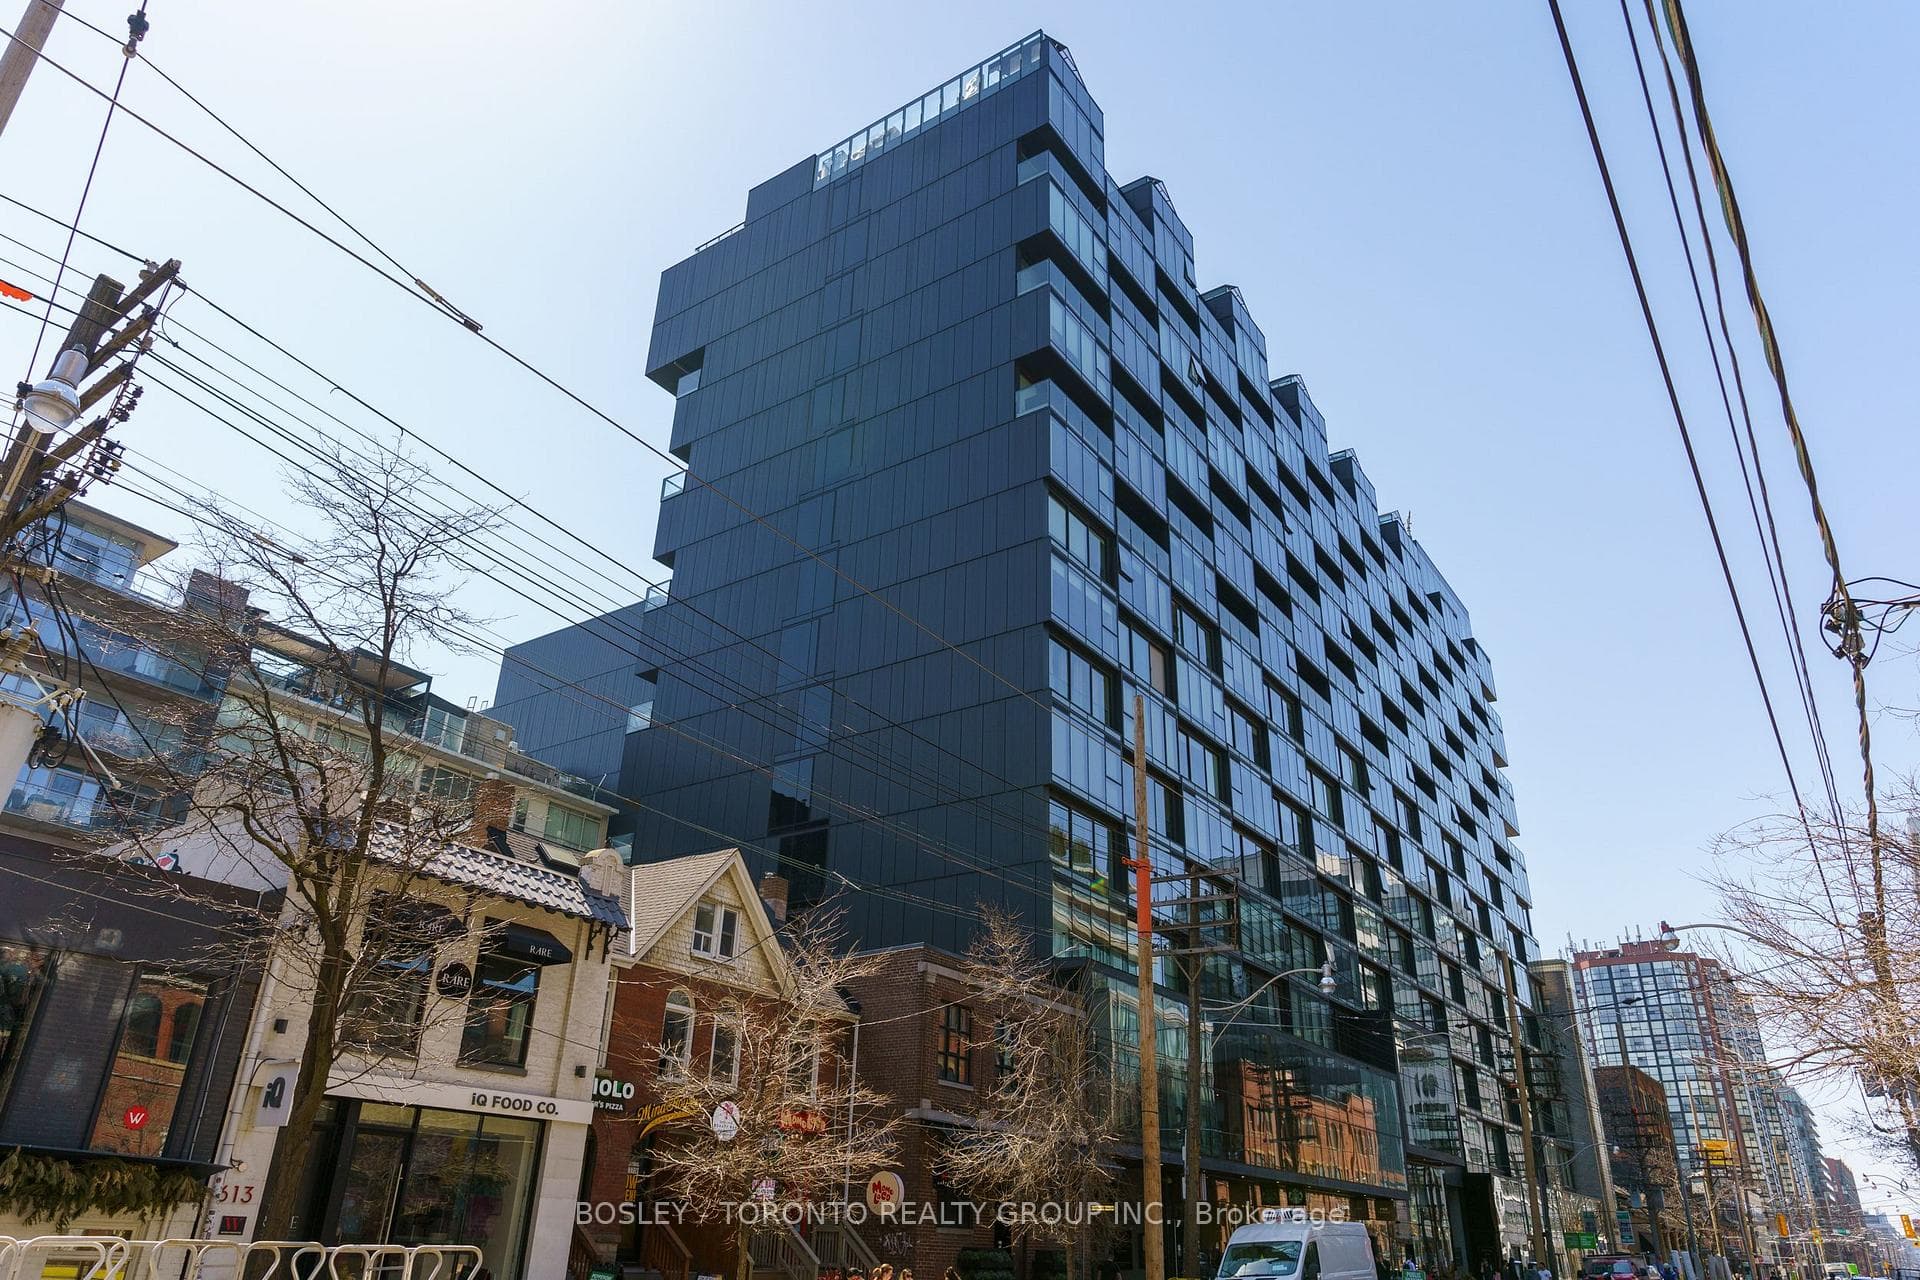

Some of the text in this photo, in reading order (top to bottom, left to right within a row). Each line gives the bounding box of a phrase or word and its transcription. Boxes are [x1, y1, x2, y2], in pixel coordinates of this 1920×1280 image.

[529, 945, 553, 958] RARE
[442, 973, 471, 987] RARE
[471, 1092, 559, 1115] iQ FOOD CO.
[605, 1102, 624, 1111] PIZZA
